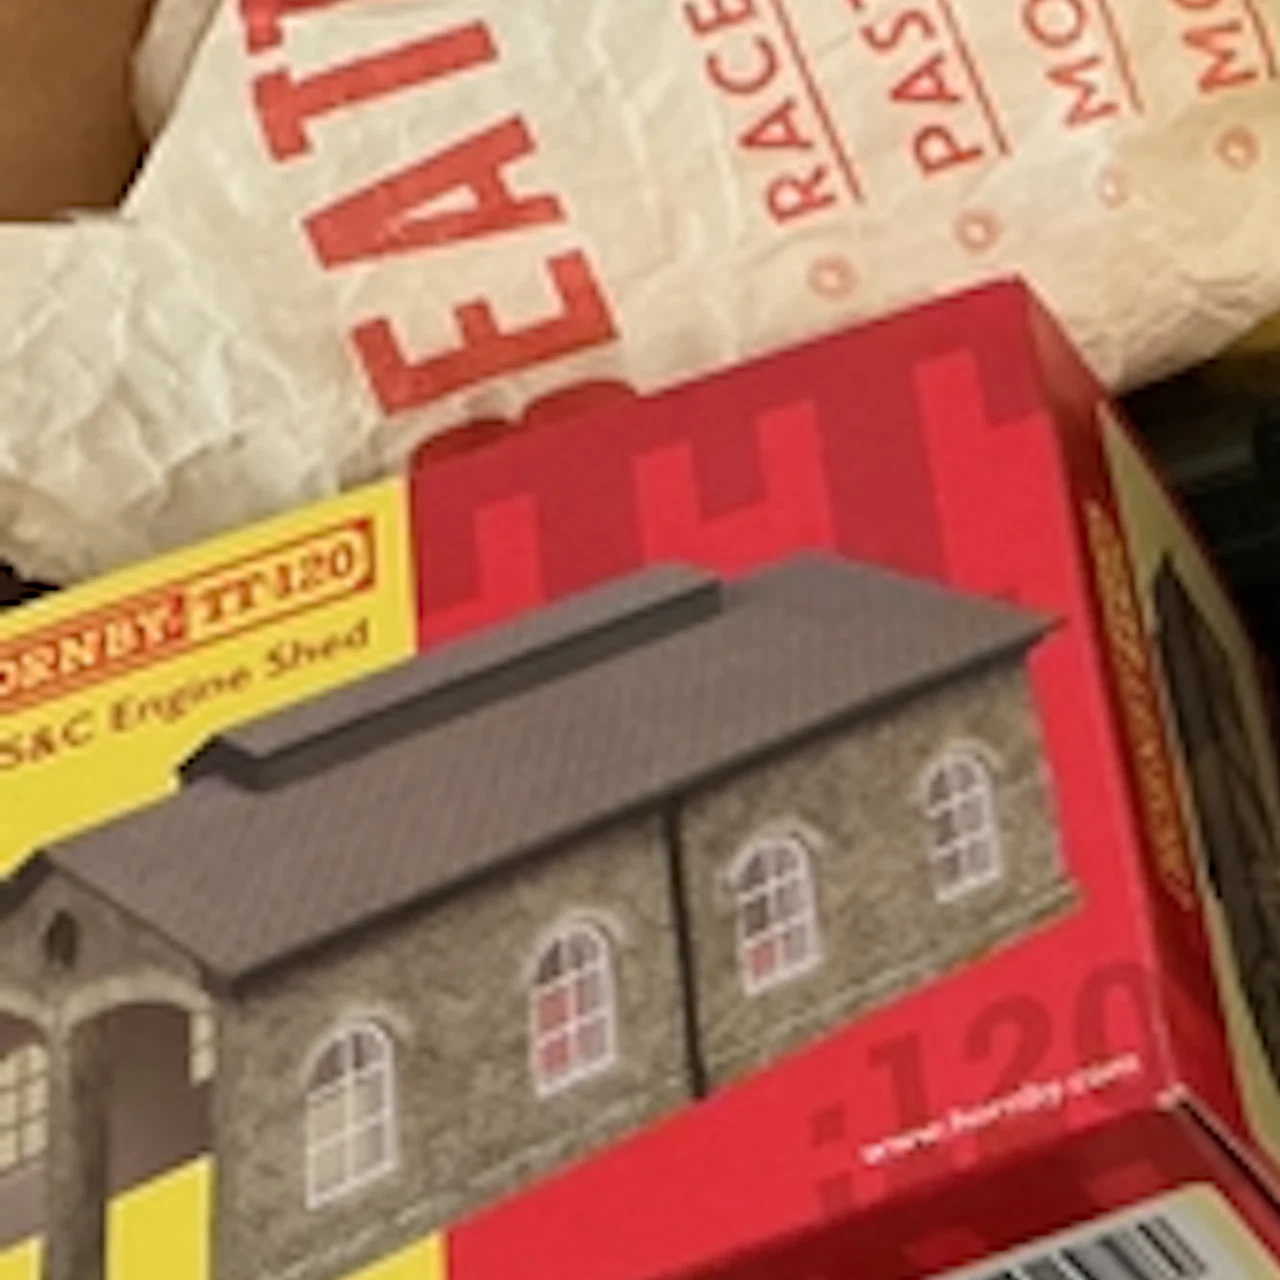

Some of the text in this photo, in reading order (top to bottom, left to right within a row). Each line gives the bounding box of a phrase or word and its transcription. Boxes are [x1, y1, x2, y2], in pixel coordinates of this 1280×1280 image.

[0, 608, 172, 698] ORNBY
[108, 666, 251, 732] Engine
[267, 617, 370, 678] Shed
